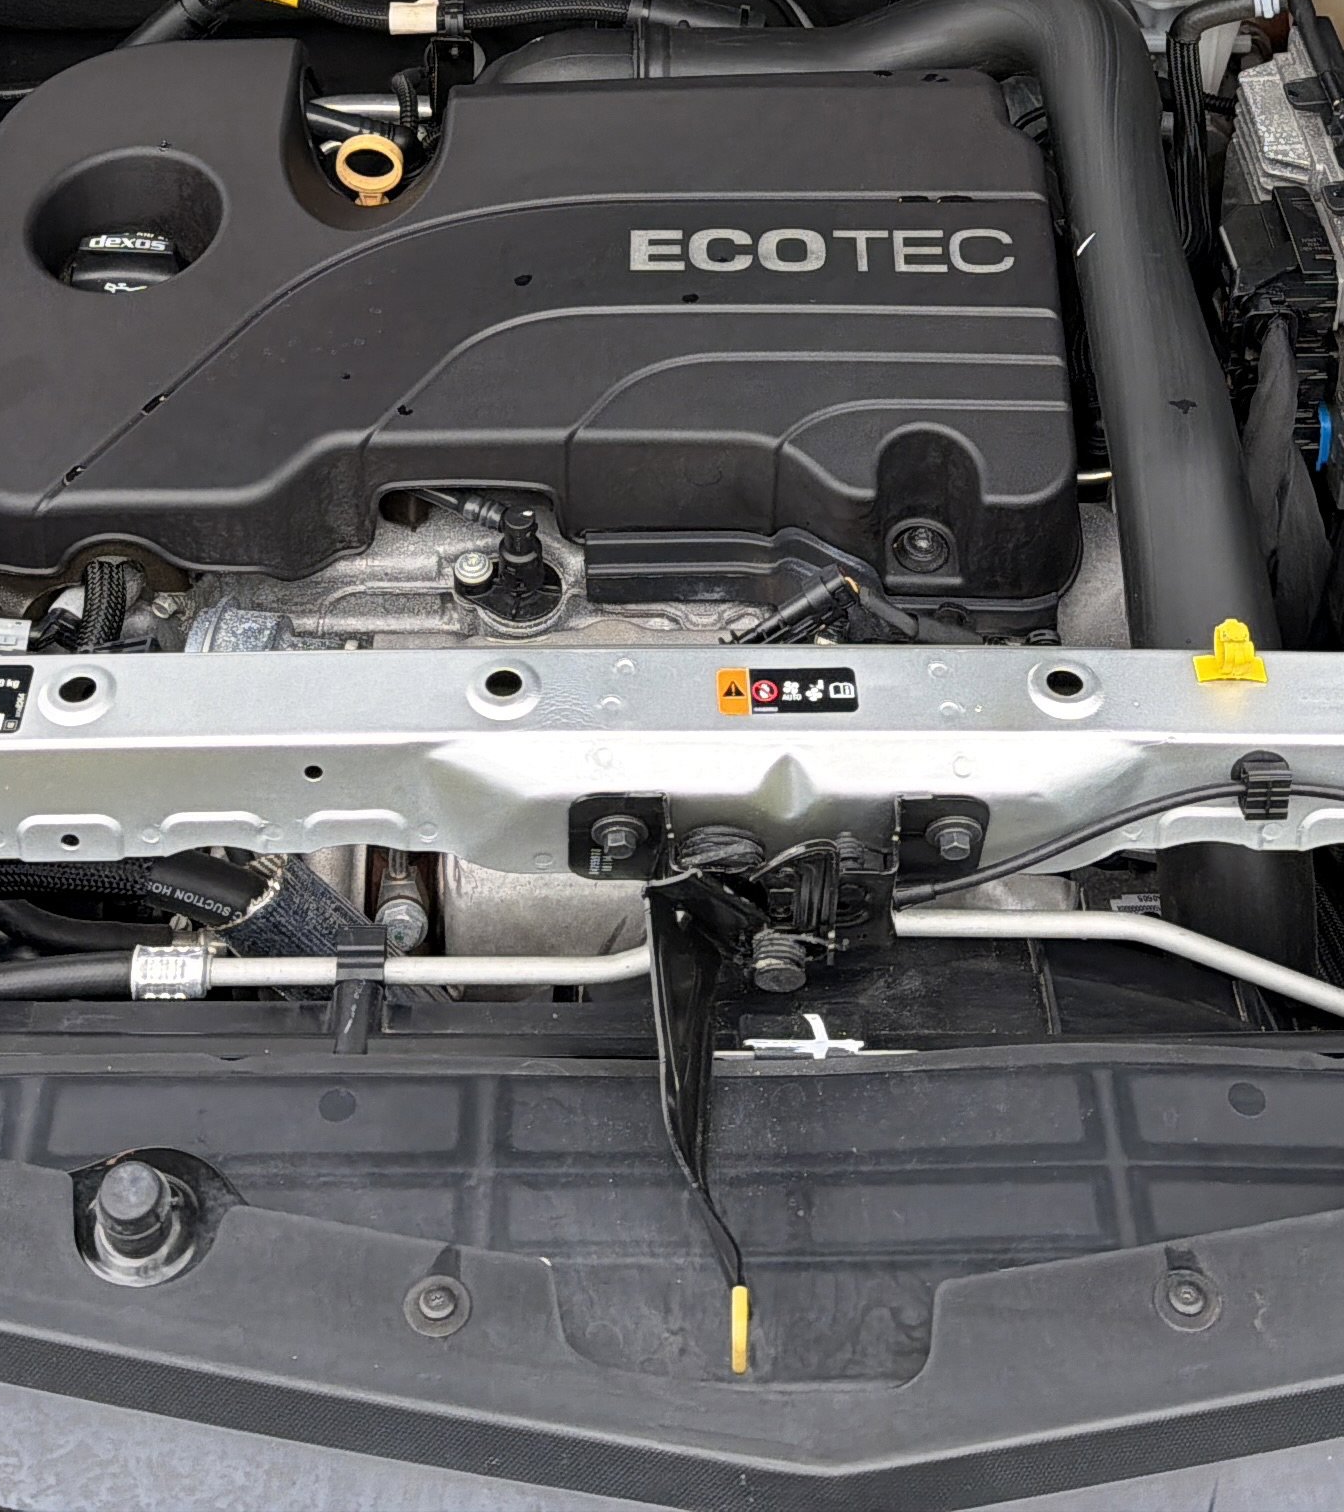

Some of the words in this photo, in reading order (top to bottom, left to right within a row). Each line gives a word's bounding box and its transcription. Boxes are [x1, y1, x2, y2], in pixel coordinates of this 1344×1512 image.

[88, 234, 167, 251] dexos
[629, 228, 1015, 274] ECOTEC
[6, 679, 20, 689] kg
[174, 888, 232, 917] SUCTION
